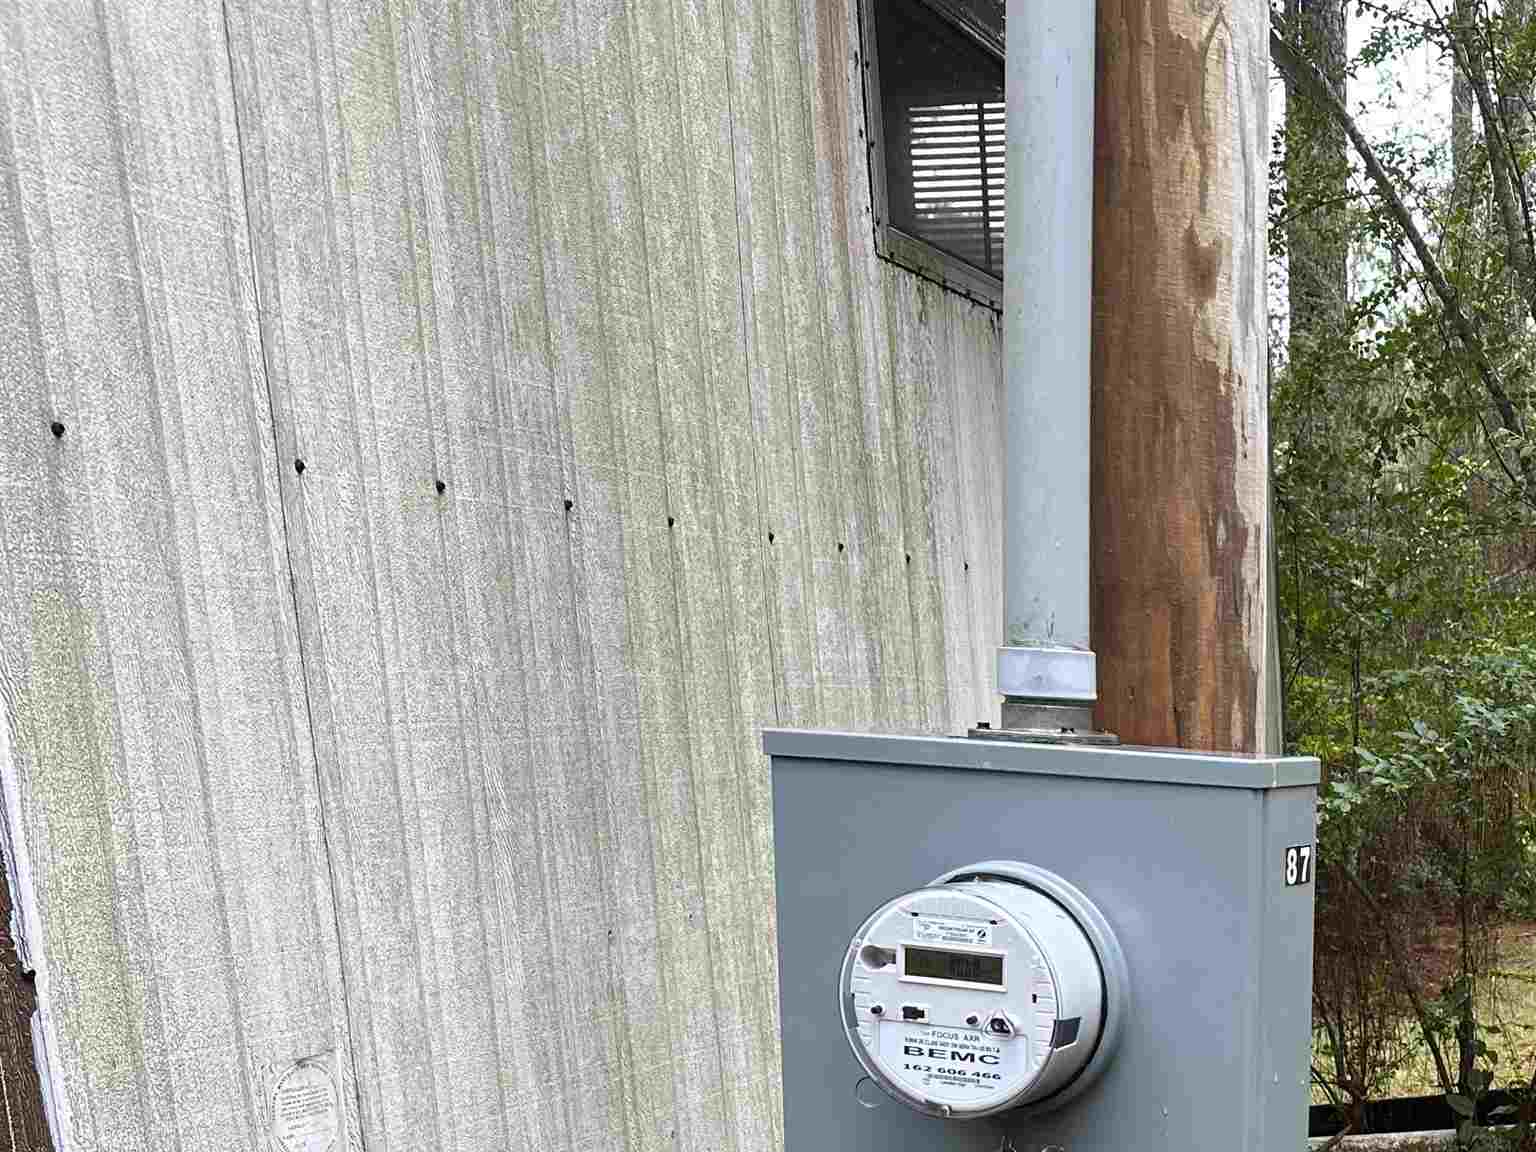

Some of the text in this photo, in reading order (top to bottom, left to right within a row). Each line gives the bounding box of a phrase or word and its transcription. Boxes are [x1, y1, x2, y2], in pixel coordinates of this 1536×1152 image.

[1286, 846, 1311, 885] 87
[931, 1030, 959, 1041] FOCUS
[903, 1045, 1001, 1065] BEMC
[903, 1063, 932, 1073] 162
[937, 1067, 967, 1077] 606
[971, 1071, 1001, 1080] 466
